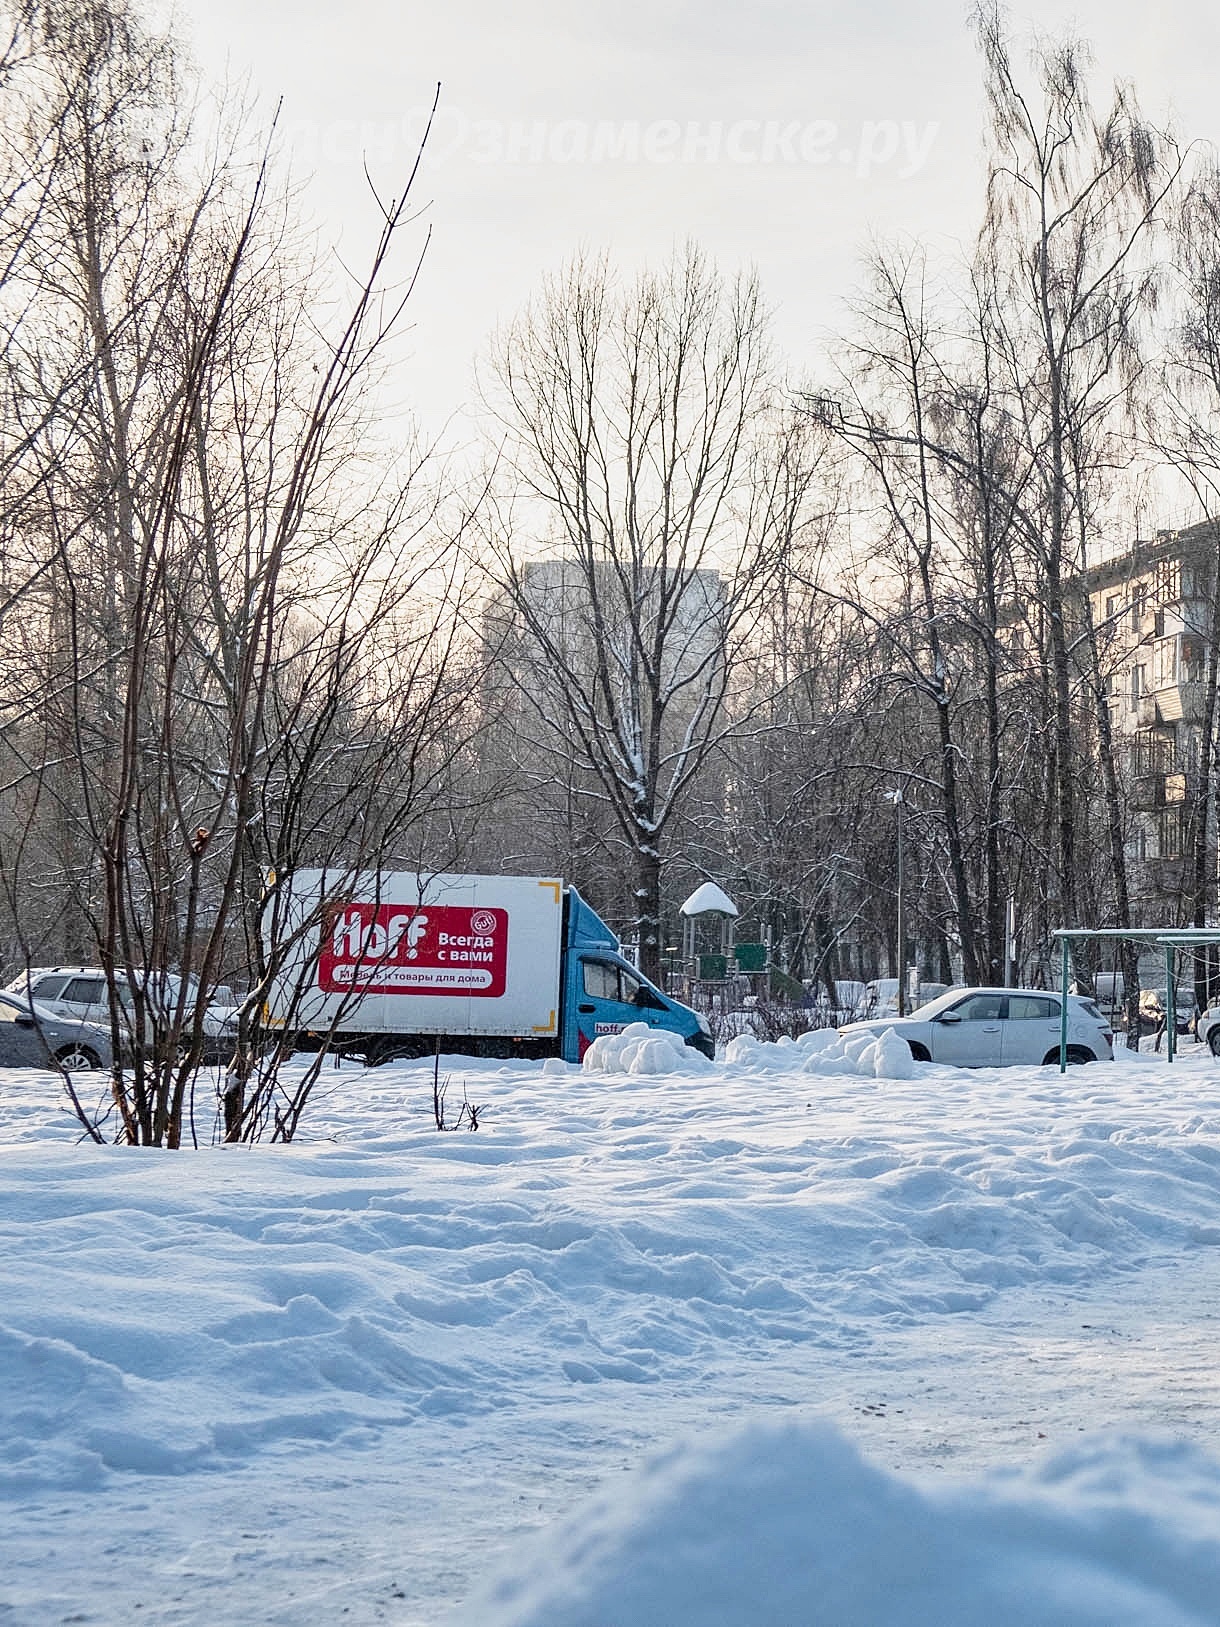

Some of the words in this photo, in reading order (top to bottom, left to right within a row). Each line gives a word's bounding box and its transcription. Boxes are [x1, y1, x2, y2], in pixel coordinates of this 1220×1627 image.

[333, 911, 429, 960] Hoff
[438, 932, 494, 948] Всегда
[438, 950, 447, 961] с
[450, 950, 493, 962] вами
[339, 969, 382, 980] Мебеь
[394, 973, 433, 983] товары
[435, 974, 455, 983] для
[457, 974, 486, 984] дома
